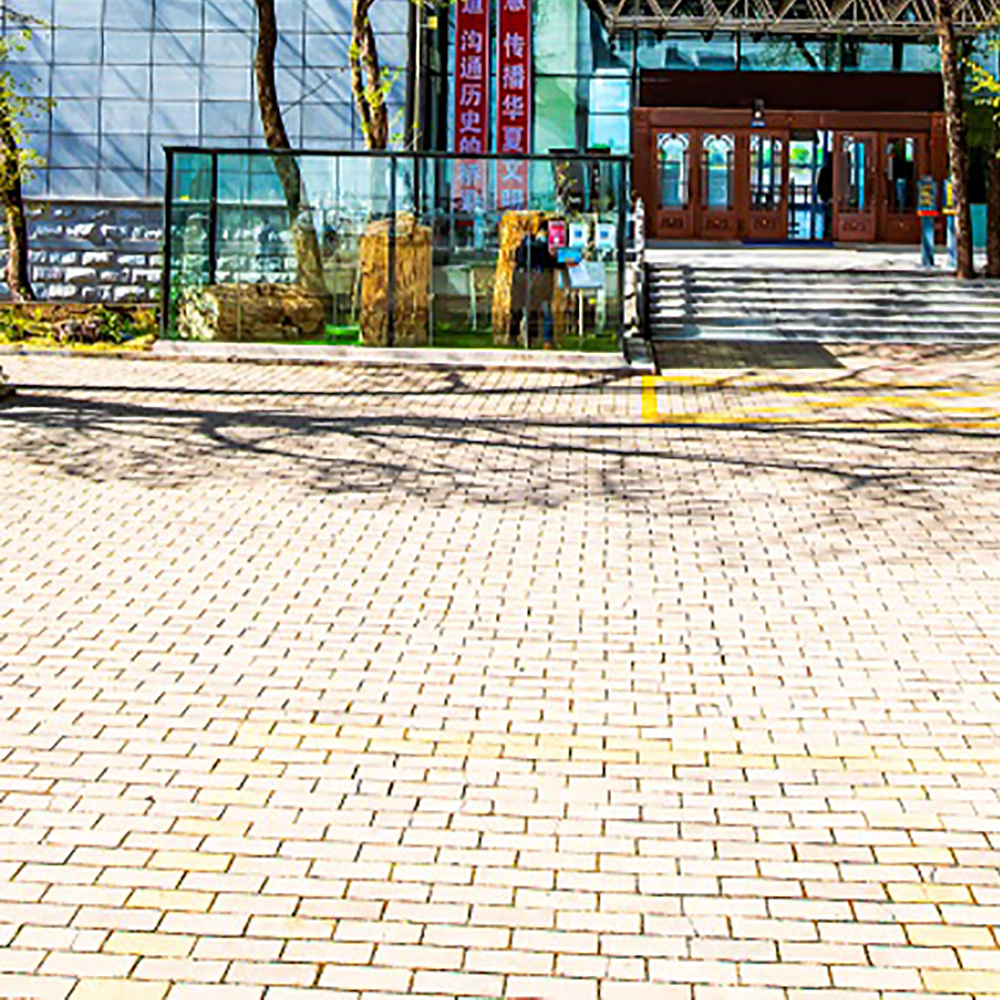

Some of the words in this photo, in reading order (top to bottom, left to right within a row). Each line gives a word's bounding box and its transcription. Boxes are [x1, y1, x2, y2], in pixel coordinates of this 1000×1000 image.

[501, 31, 525, 210] 传播华夏文明
